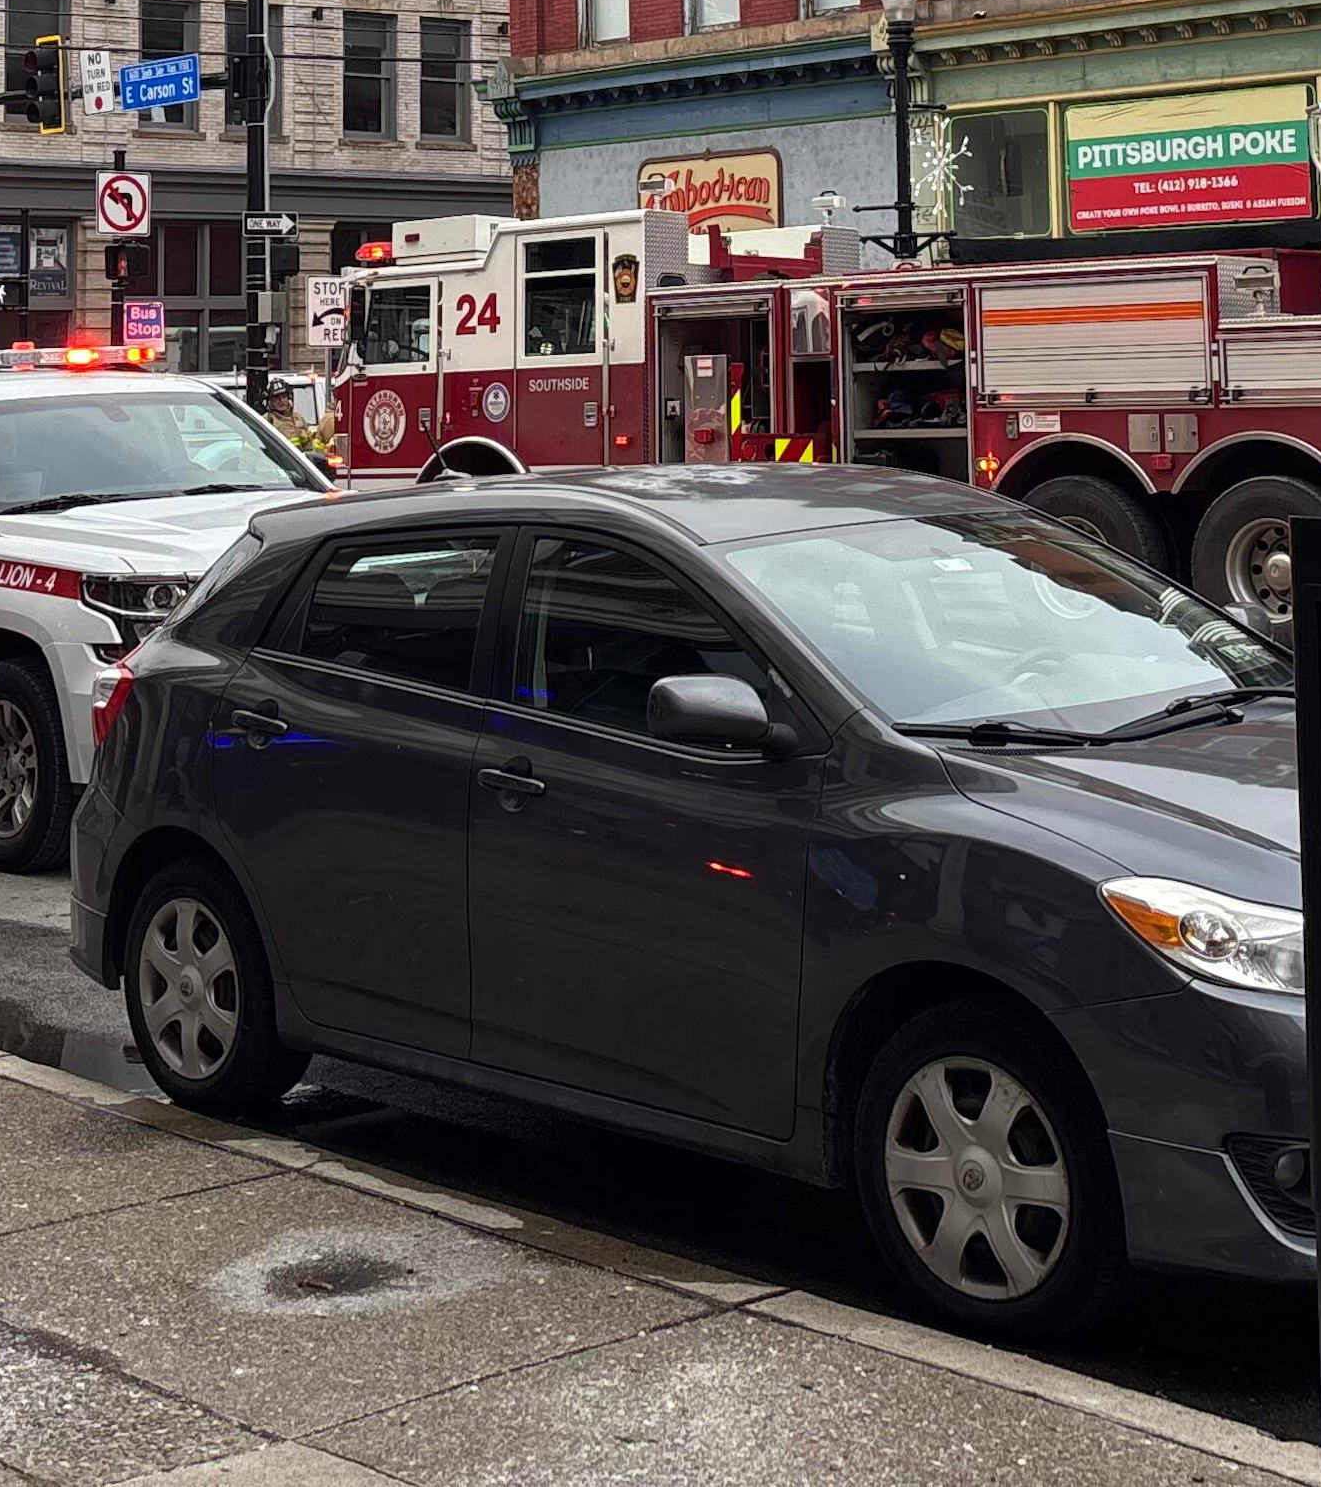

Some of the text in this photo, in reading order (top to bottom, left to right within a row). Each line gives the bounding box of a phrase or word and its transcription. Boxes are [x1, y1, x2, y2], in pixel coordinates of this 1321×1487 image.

[88, 53, 101, 65] NO
[87, 68, 106, 79] TURN
[84, 81, 110, 94] ON RED
[126, 77, 194, 104] E Carson St
[1078, 129, 1297, 169] PITTSBURGH POKE
[1133, 175, 1239, 194] TEL: (412) 918-1366
[1076, 208, 1102, 220] CREATE
[1102, 208, 1121, 218] YOUR
[1122, 207, 1139, 217] OWN
[1139, 206, 1159, 216] POKE
[1252, 198, 1276, 209] ASIAN
[1277, 196, 1307, 208] FUSION
[249, 219, 281, 229] ONE WAY
[319, 297, 340, 306] HERE
[130, 307, 157, 320] Bus
[331, 317, 341, 326] ON
[455, 292, 501, 336] 24
[128, 322, 161, 338] Stop
[529, 376, 590, 393] SOUTHSIDE
[44, 571, 58, 593] 4
